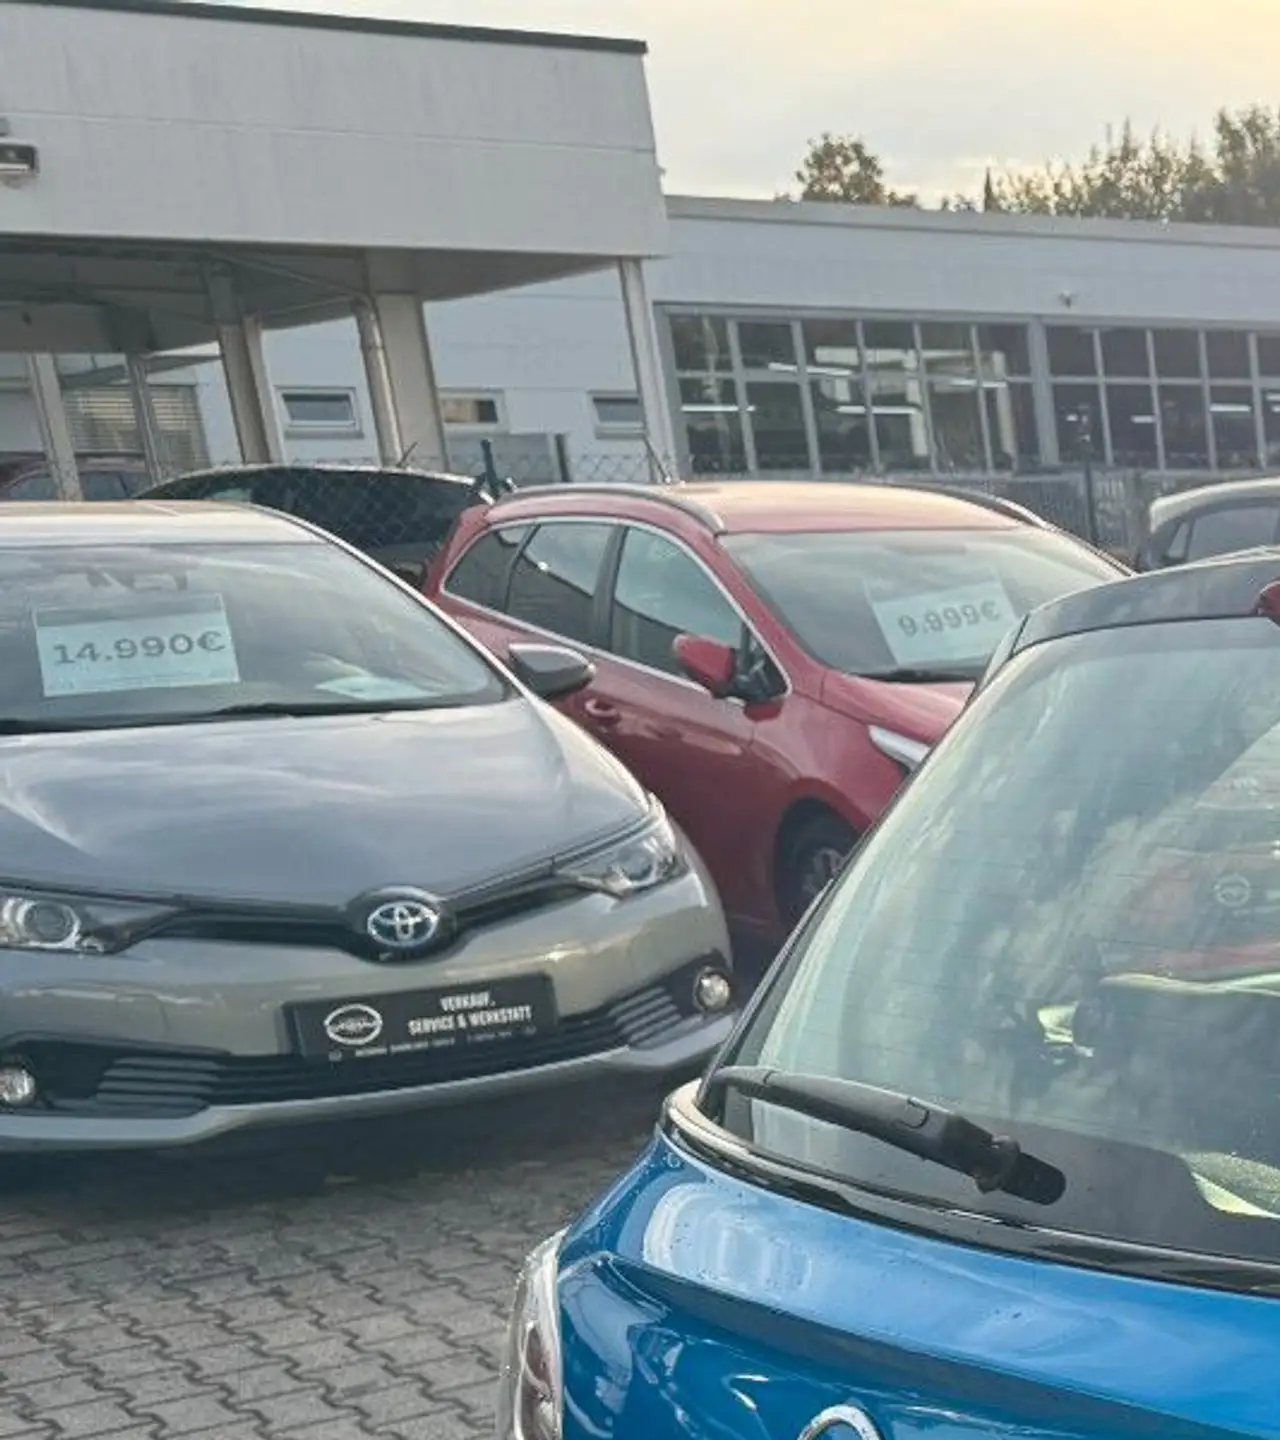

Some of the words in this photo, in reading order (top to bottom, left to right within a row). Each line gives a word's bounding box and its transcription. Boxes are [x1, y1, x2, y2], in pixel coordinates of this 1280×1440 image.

[53, 631, 226, 664] 14.990€
[408, 1014, 455, 1036] SERVICE
[457, 1013, 467, 1029] &
[468, 1005, 533, 1027] WERKSTATT
